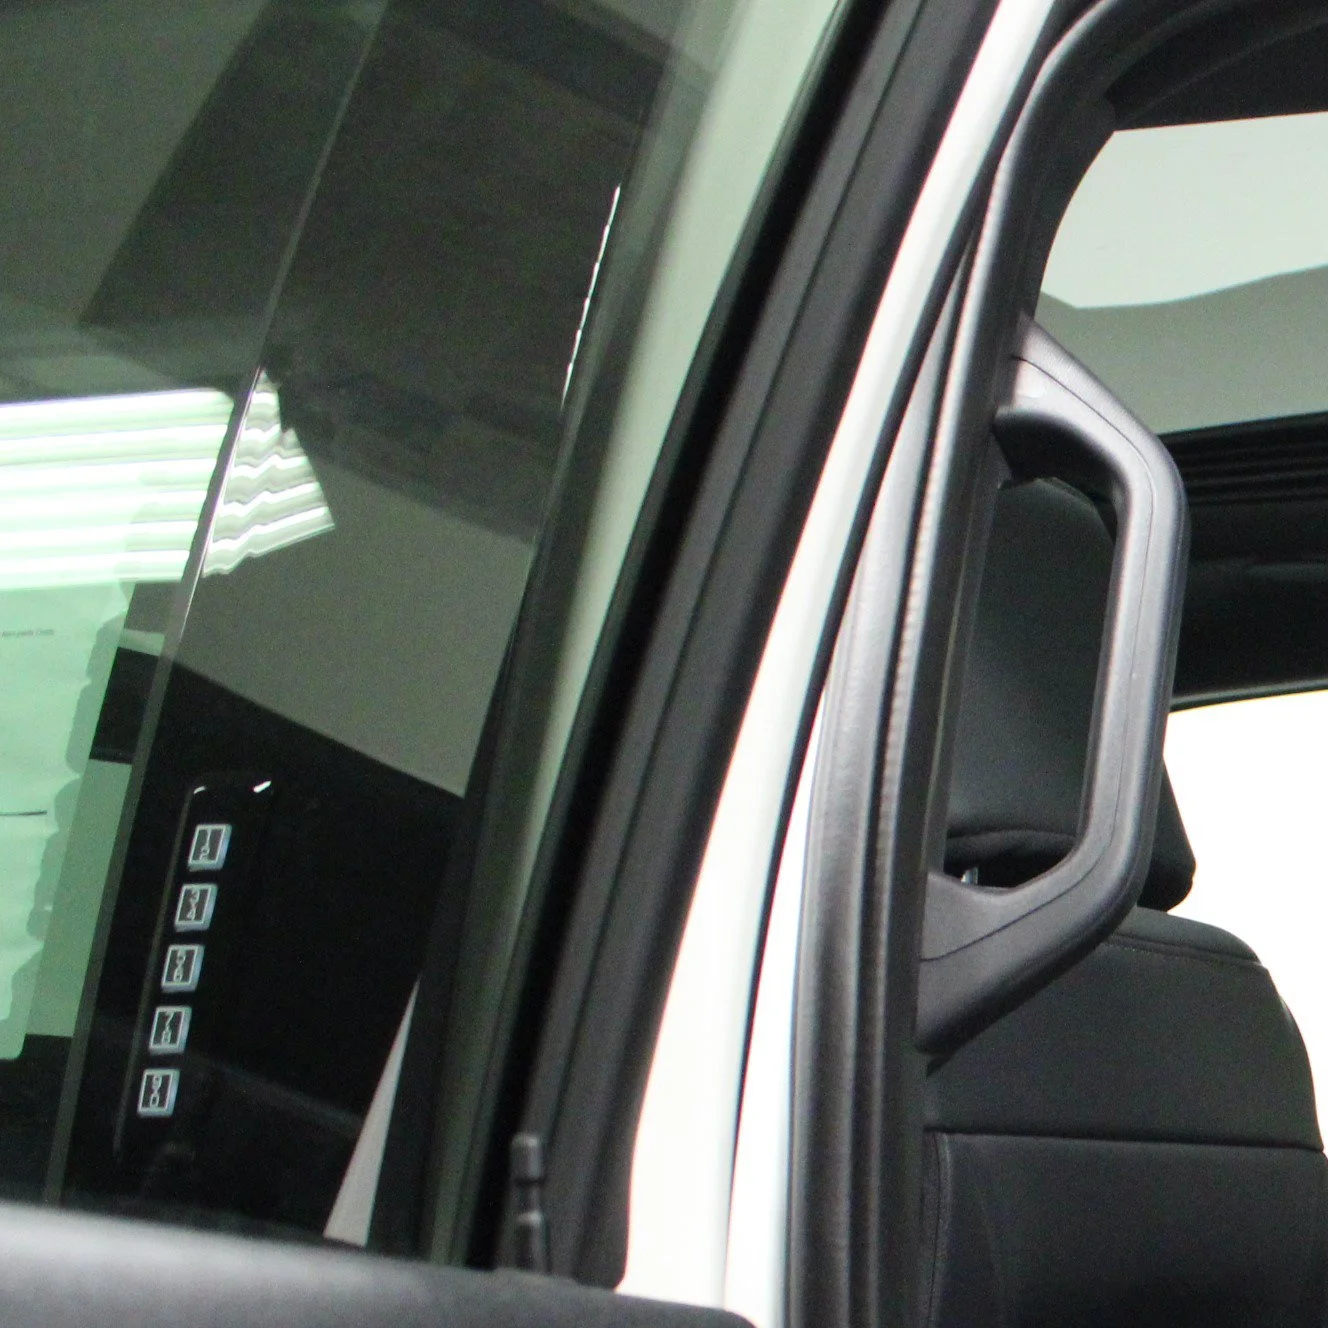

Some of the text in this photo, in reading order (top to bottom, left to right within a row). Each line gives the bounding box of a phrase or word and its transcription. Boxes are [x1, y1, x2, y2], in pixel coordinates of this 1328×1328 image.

[199, 846, 210, 860] 2
[189, 888, 200, 904] 3
[164, 1011, 175, 1027] 7
[152, 1074, 163, 1090] 9
